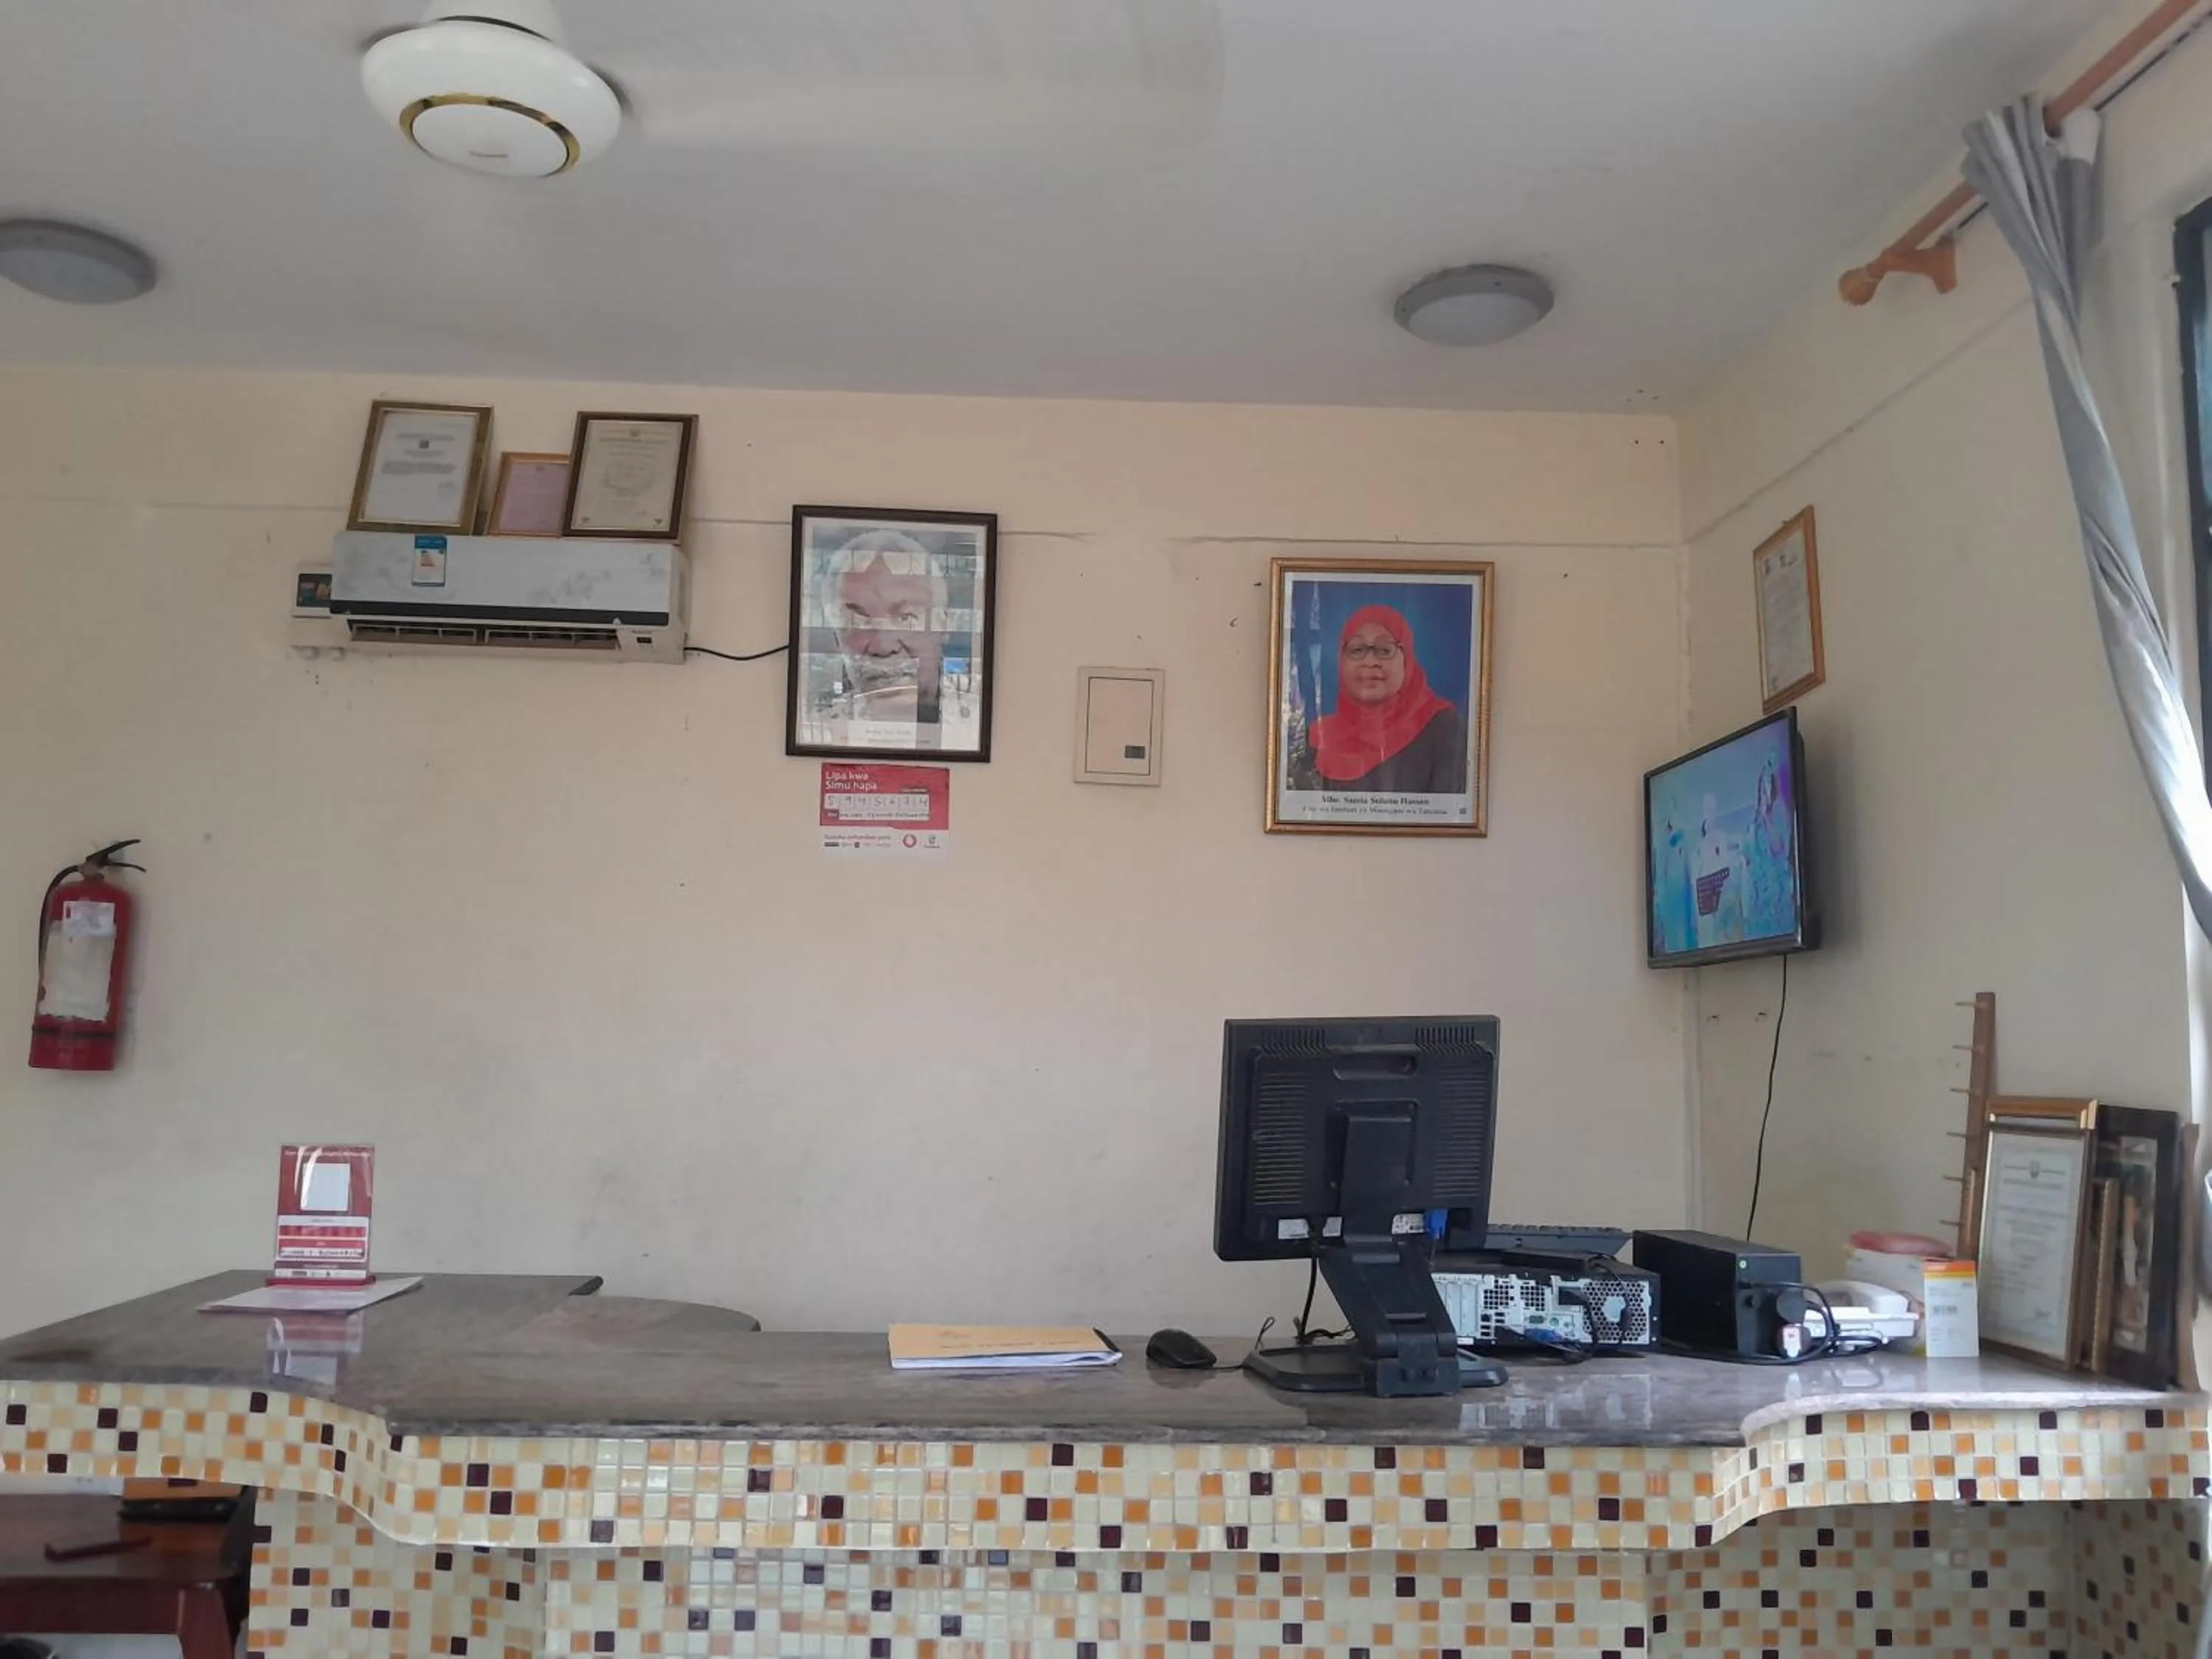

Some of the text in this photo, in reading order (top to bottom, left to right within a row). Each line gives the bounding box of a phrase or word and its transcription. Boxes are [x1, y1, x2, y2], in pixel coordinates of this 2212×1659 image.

[849, 771, 869, 780] kwa
[825, 780, 878, 792] Simu hapa
